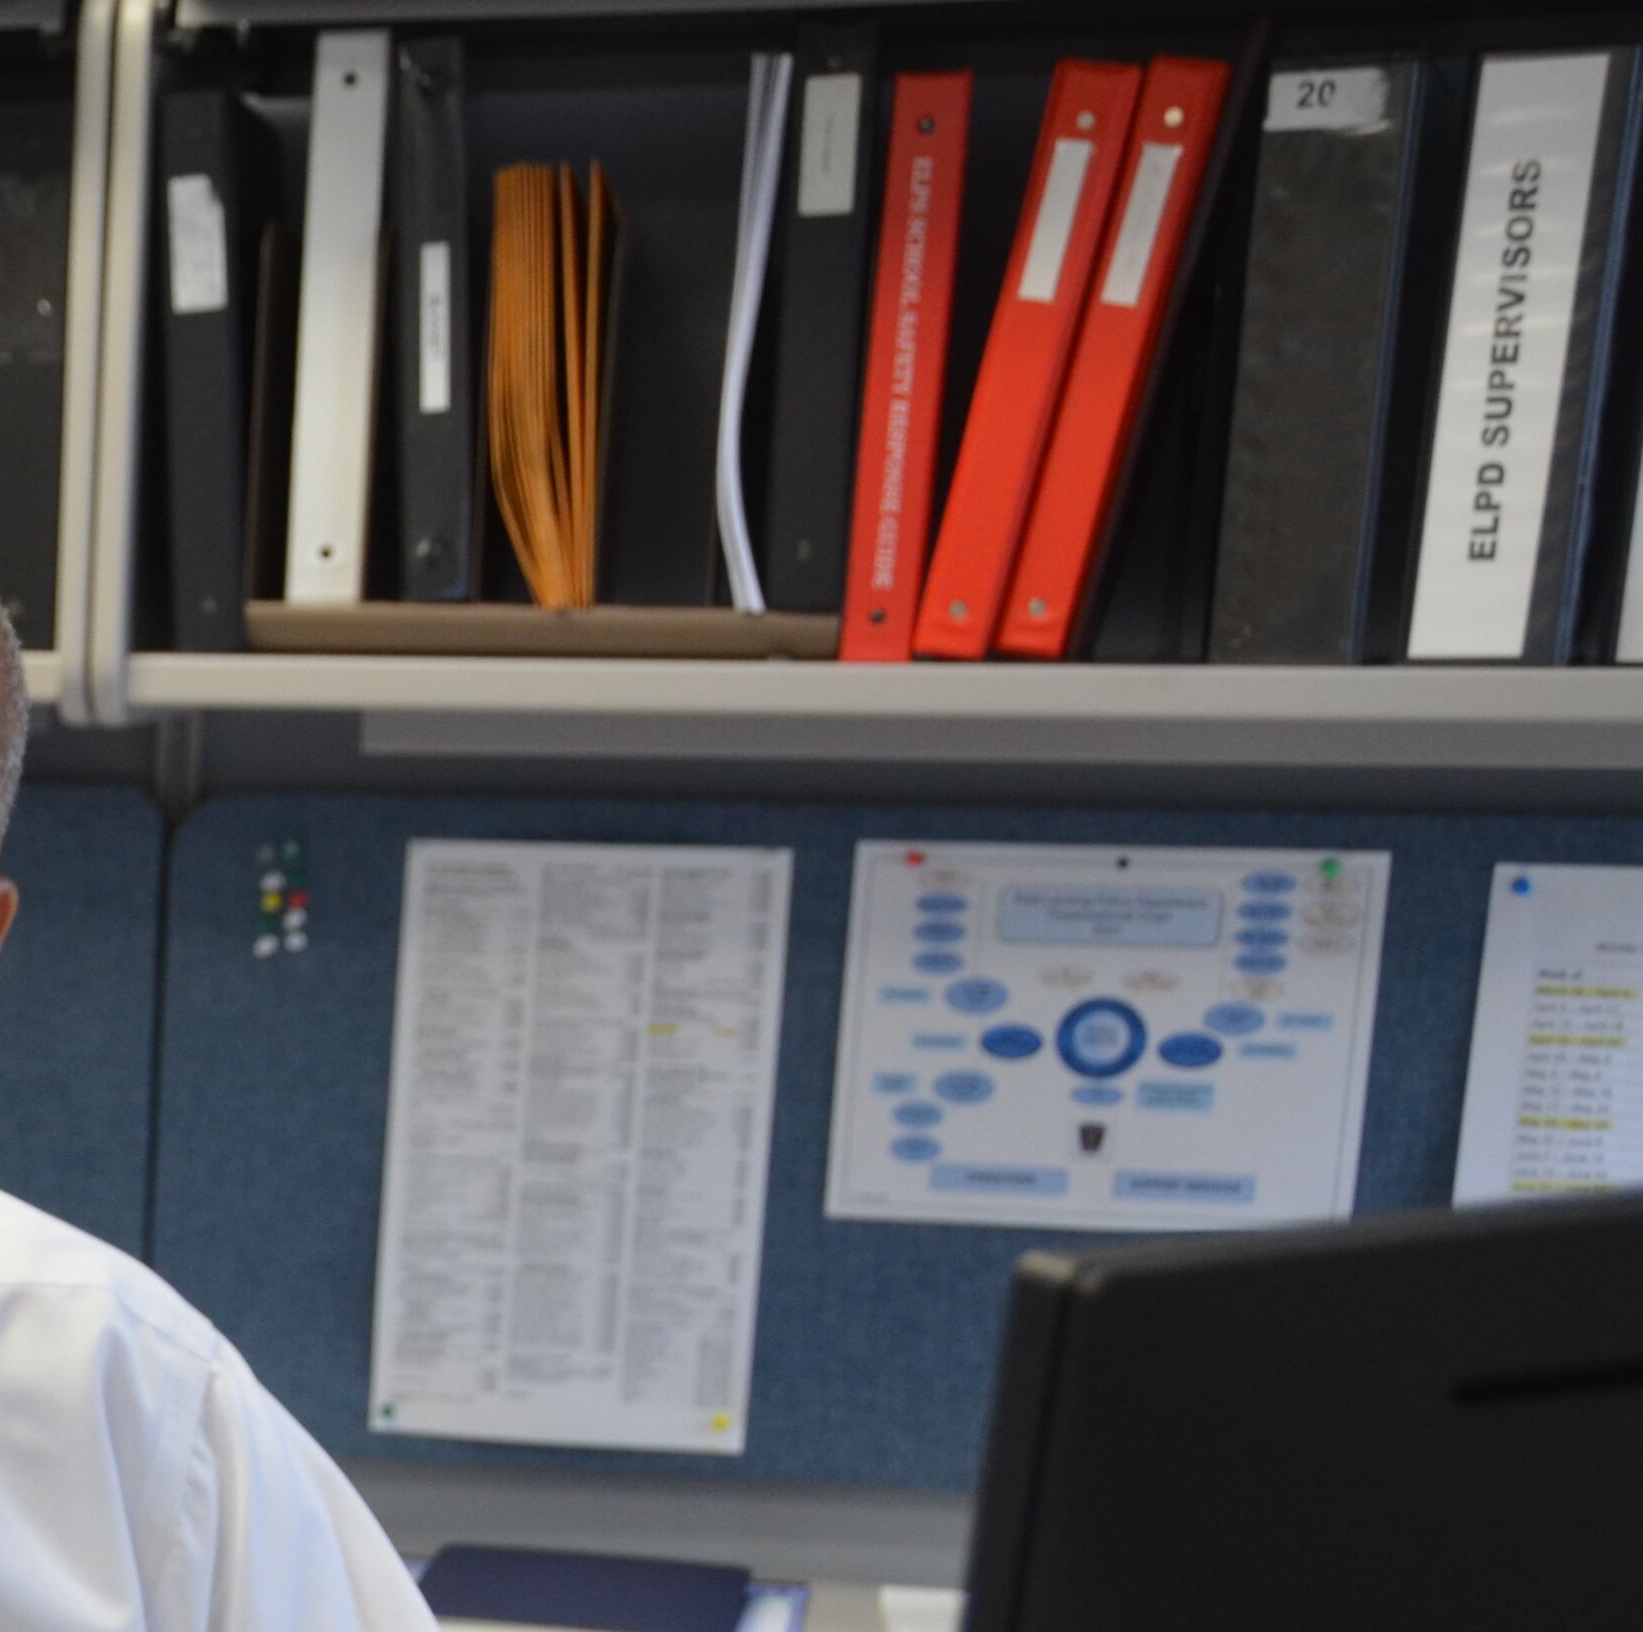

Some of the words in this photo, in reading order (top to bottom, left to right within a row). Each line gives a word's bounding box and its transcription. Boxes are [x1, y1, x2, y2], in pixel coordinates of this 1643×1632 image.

[899, 215, 931, 304] SCHOOL
[1481, 157, 1543, 448] SUPERVISORS
[891, 306, 919, 396] SAFETY
[878, 398, 910, 514] RESPONSE
[871, 514, 899, 590] GUIDE
[1467, 461, 1506, 562] ELPD
